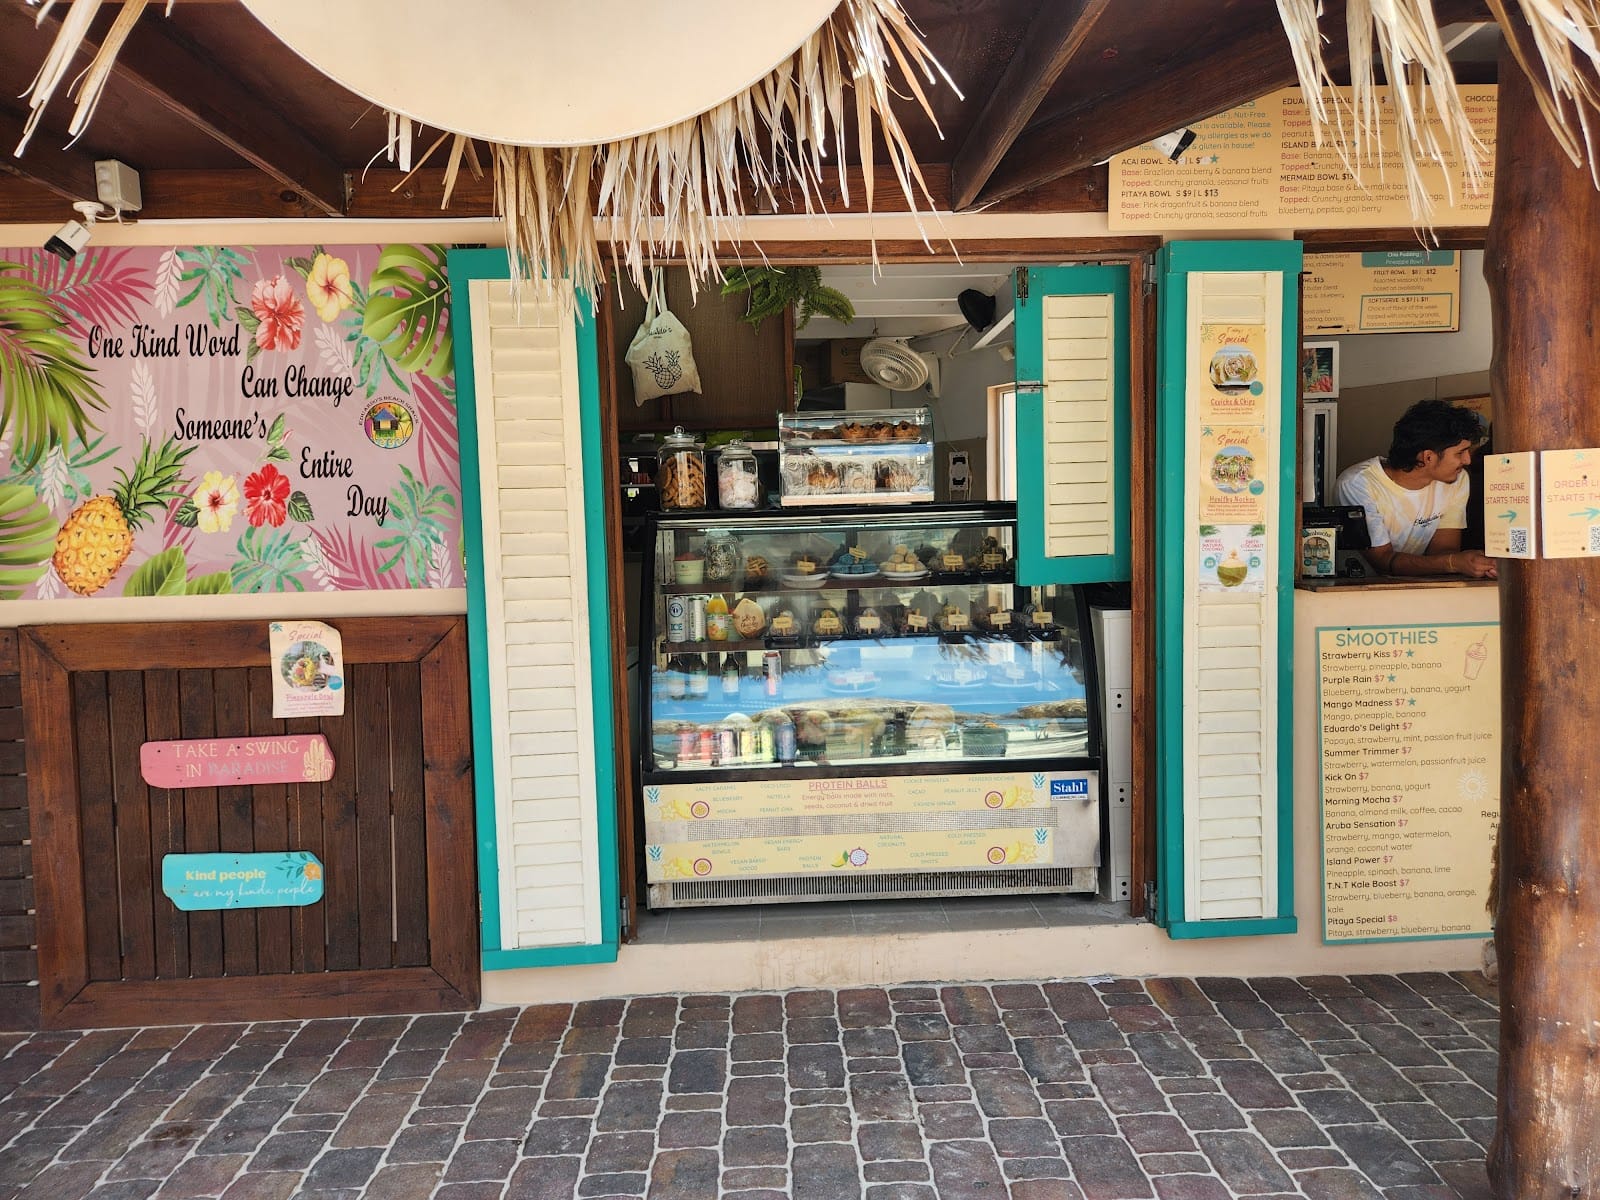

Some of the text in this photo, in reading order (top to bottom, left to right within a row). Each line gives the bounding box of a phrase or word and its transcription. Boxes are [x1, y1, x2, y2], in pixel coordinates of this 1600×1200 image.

[1281, 141, 1309, 149] ISLAND
[1122, 158, 1138, 166] ACAI
[1280, 173, 1340, 182] MERMAID BOWL
[1122, 190, 1148, 198] PITAYA
[1150, 190, 1172, 198] BOWL
[1183, 190, 1192, 198] $9
[1204, 189, 1219, 197] $13
[1250, 210, 1268, 218] fruits
[88, 323, 241, 359] One Kind Word
[1217, 333, 1249, 345] Special
[241, 364, 354, 408] Can Change
[174, 407, 267, 442] Someone's
[1217, 434, 1249, 446] Special
[300, 446, 354, 480] Entire
[1489, 482, 1526, 492] ORDER LINE
[1554, 480, 1589, 489] ORDER
[1486, 496, 1530, 505] STARTS THERE
[1546, 494, 1585, 503] STARTS
[346, 484, 390, 528] Day
[289, 630, 322, 642] Special
[1336, 630, 1438, 647] SMOOTHIES
[1322, 650, 1403, 660] Strawberry Kiss $7
[1322, 662, 1442, 672] Strawberry, pineapple, banana
[1322, 674, 1384, 685] Purple Rain $7
[1323, 684, 1471, 697] Blueberry, strawberry, banana, yogurt
[1323, 698, 1405, 710] Mango Madness $7
[1324, 714, 1352, 722] Mango,
[1354, 712, 1394, 720] pineapple,
[1324, 722, 1412, 733] Eduardo's Delight $7
[1324, 738, 1356, 746] Papaya,
[1357, 736, 1402, 744] strawberry,
[1424, 734, 1454, 742] passion
[1456, 732, 1472, 740] fruit
[1474, 732, 1493, 742] juice
[172, 740, 300, 758] TAKE A SWING
[1324, 746, 1412, 758] Summer Trimmer $7
[186, 759, 288, 778] IN PARADISE
[1324, 756, 1486, 770] Strawberry, watermelon, passionfruit juice
[1359, 772, 1369, 780] $7
[808, 779, 888, 790] PROTEIN BALLS
[1053, 781, 1084, 793] Stahl
[1325, 783, 1431, 794] Strawberry, banana, yogurt
[826, 792, 842, 800] balls
[844, 792, 862, 800] made
[1326, 795, 1403, 806] Morning Mocha $7
[1326, 810, 1357, 818] Banana,
[1358, 808, 1388, 816] almond
[1438, 806, 1462, 814] cacao
[1326, 819, 1408, 830] Aruba Sensation $7
[1326, 831, 1452, 842] Strawberry, mango, watermelon,
[1326, 843, 1412, 854] orange, coconut water
[1326, 858, 1352, 866] Island
[1383, 856, 1394, 864] $7
[186, 869, 266, 883] Kind people
[1326, 870, 1366, 878] Pineapple,
[1401, 866, 1432, 875] banana,
[1434, 866, 1451, 874] lime
[1328, 878, 1410, 890] T.N.T Kale Boost $7
[194, 890, 212, 898] are
[216, 889, 234, 906] my
[278, 878, 314, 901] people
[1327, 894, 1372, 902] Strawberry,
[1447, 889, 1476, 898] orange,
[1328, 906, 1344, 914] kale
[1328, 918, 1354, 926] Pitaya
[1356, 916, 1386, 925] Special
[1356, 928, 1400, 936] strawberry,
[1401, 926, 1440, 935] blueberry,
[1442, 924, 1471, 932] banana
